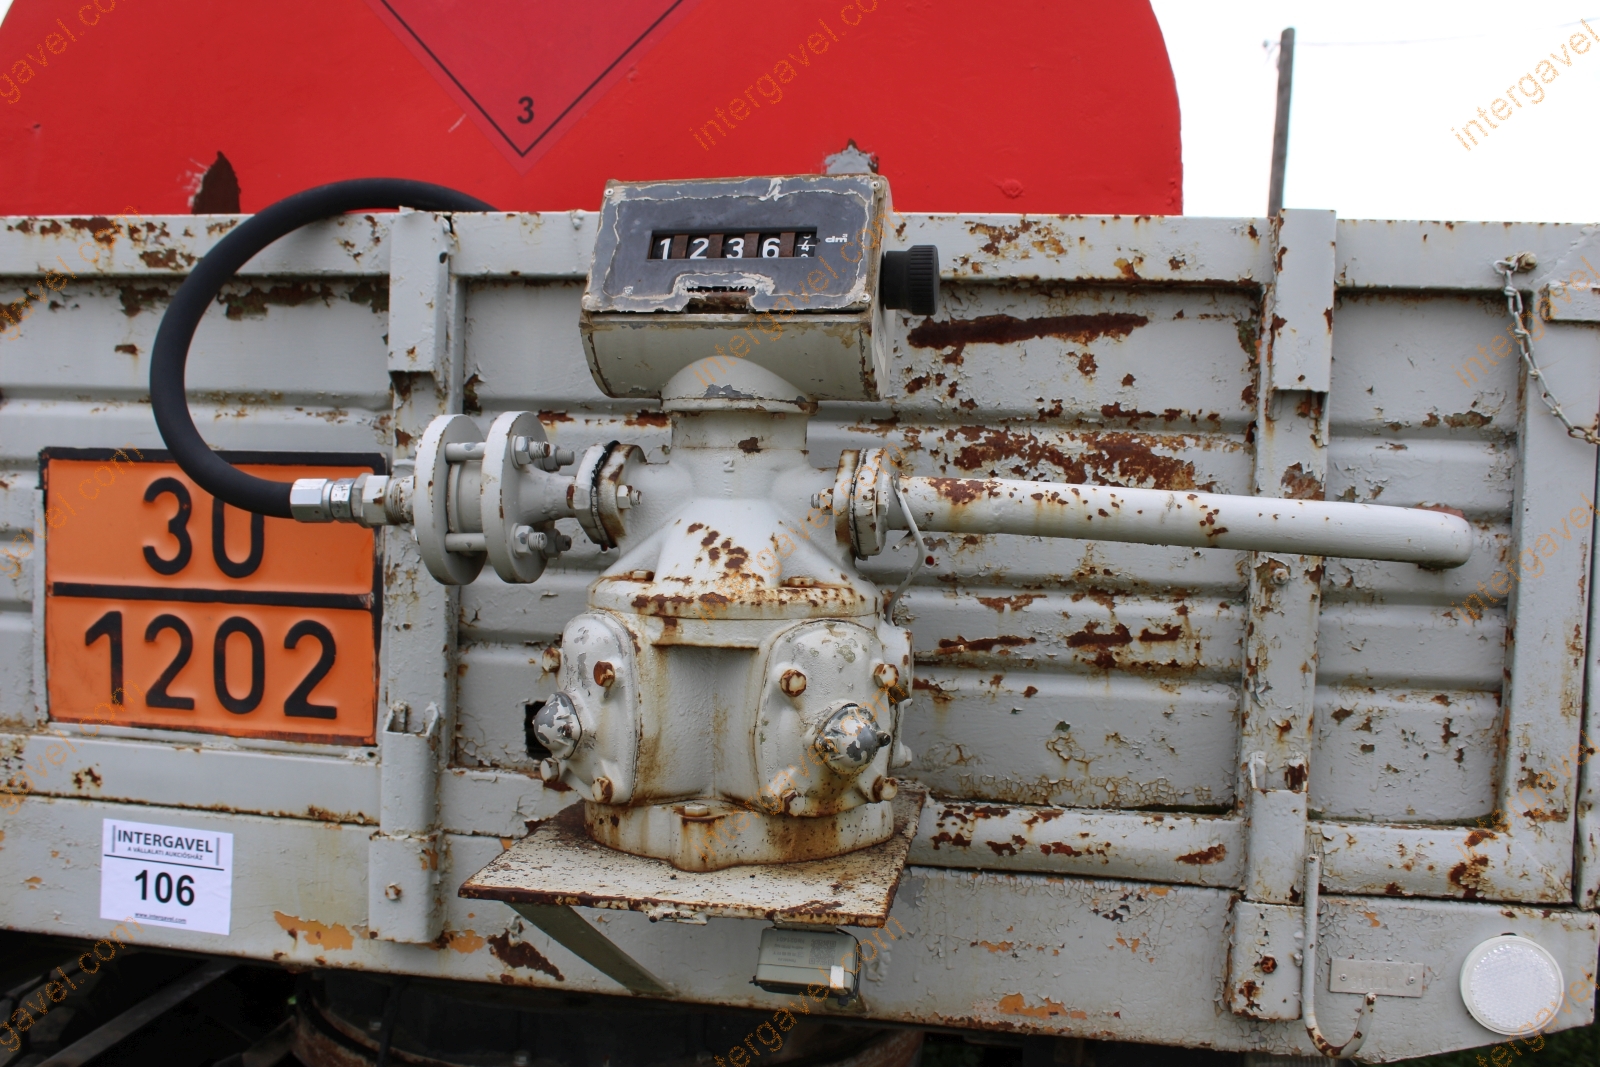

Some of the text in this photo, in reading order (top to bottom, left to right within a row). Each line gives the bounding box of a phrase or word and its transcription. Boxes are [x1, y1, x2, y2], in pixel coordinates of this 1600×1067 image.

[517, 96, 534, 124] 3
[142, 476, 265, 579] 30
[85, 610, 337, 720] 1202
[118, 829, 213, 853] INTERGAVEL
[134, 869, 195, 907] 106
[135, 912, 187, 925] www.intergavel.com
